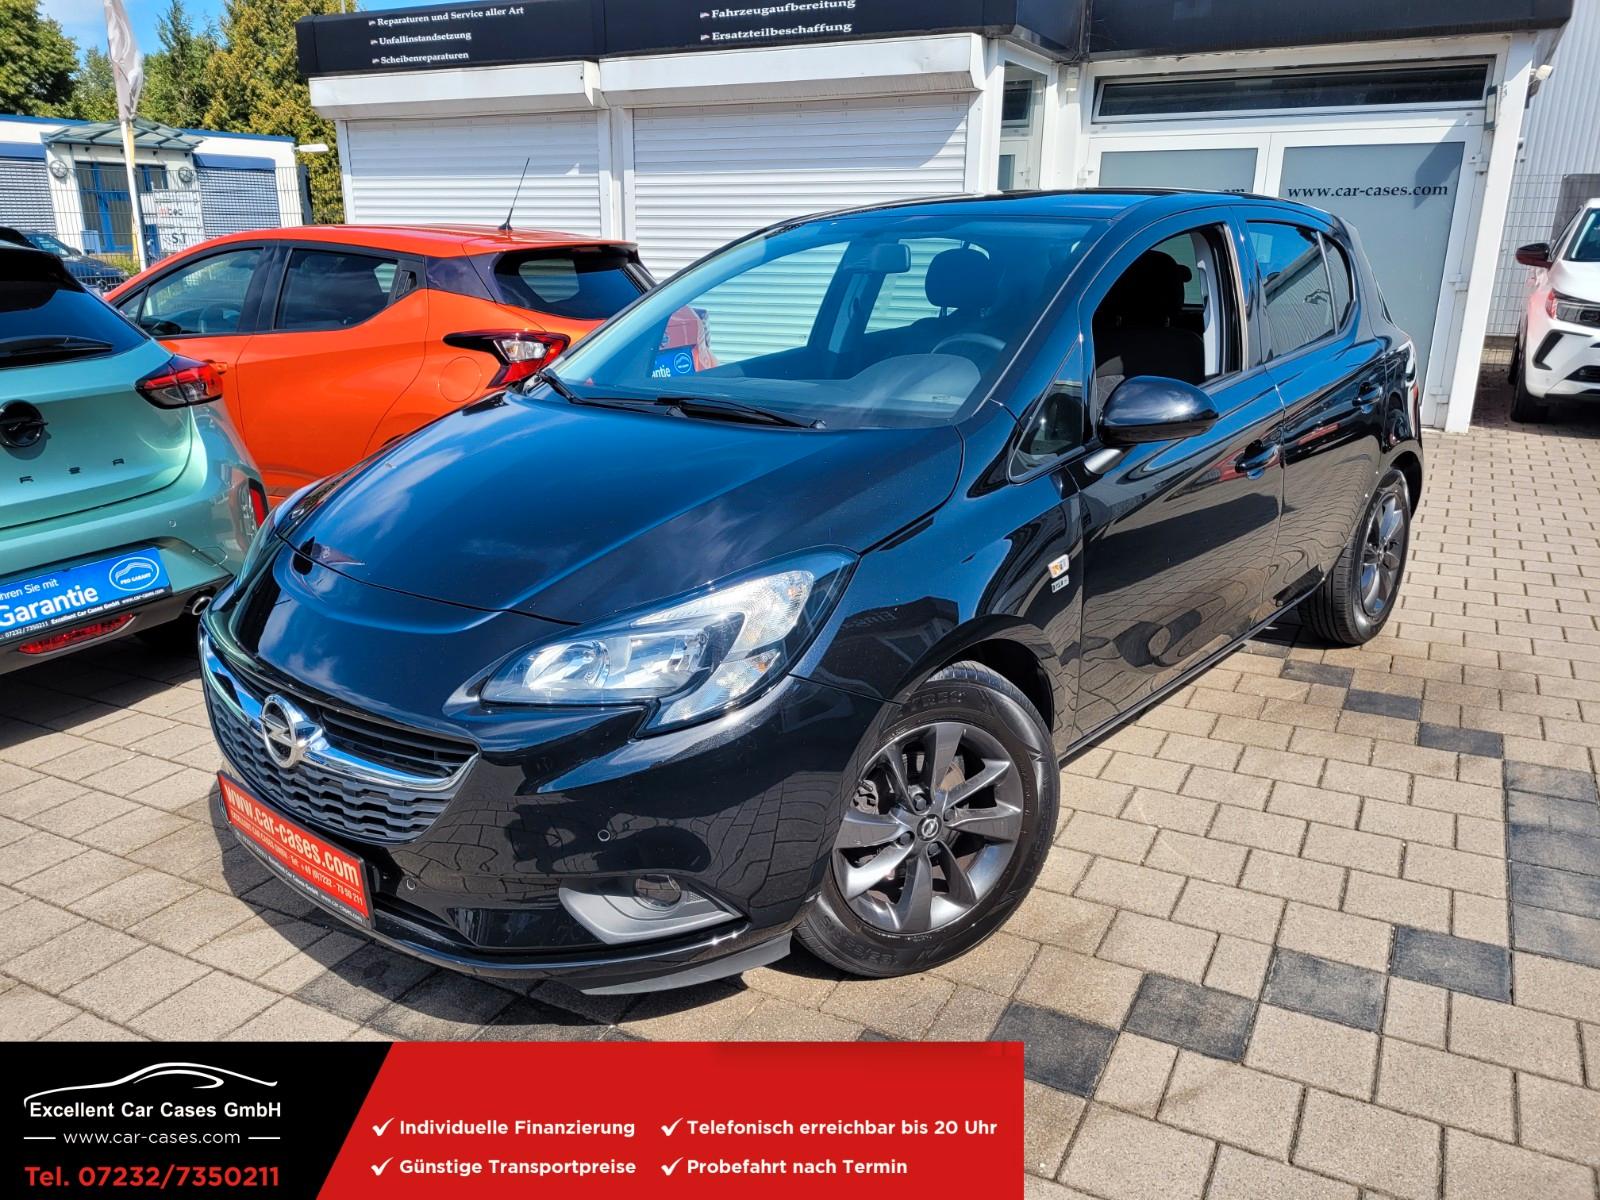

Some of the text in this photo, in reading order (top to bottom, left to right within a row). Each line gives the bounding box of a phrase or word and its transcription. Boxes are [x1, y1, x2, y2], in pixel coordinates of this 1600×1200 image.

[377, 6, 525, 27] Reparaturen und Service aller Art
[711, 0, 856, 18] Fahrzeugaufbereitung
[379, 31, 472, 46] Unfallinstandsetzung
[711, 23, 852, 41] Ersatzteilbeschaffung
[380, 51, 469, 65] Scheibenreparaturen
[1287, 184, 1449, 198] www.car-cases.com
[24, 584, 41, 594] Sie
[42, 578, 59, 590] mit
[0, 584, 99, 627] Garantie
[223, 783, 360, 887] www.car-cases.com
